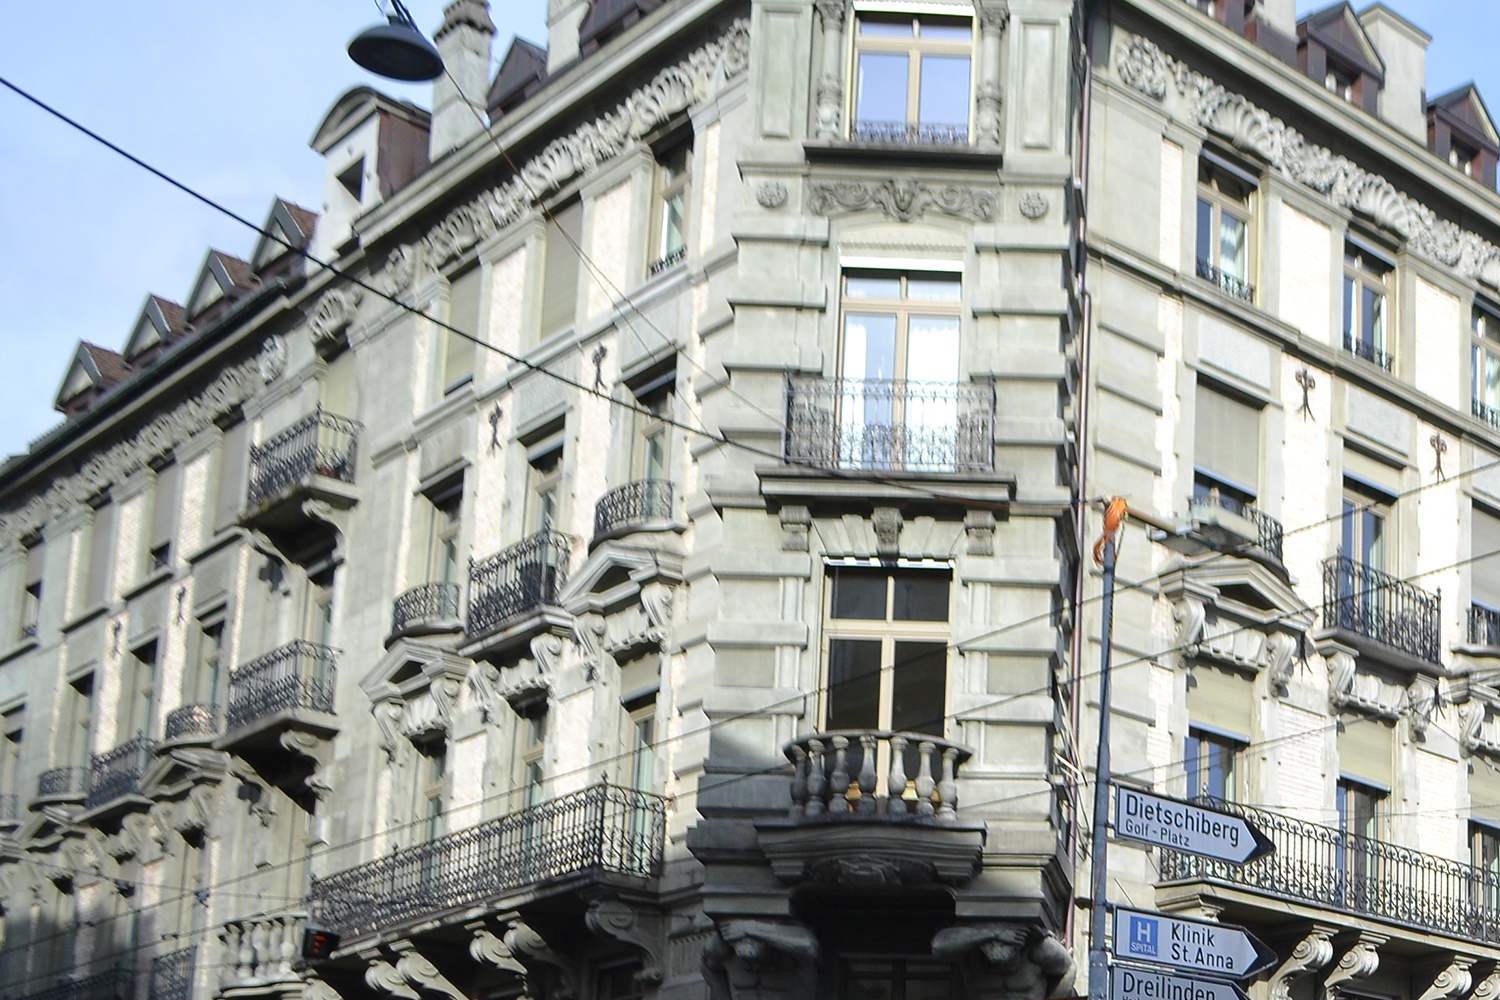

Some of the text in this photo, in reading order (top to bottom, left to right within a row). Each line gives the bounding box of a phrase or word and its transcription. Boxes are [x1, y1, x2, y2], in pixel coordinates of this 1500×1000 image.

[1125, 818, 1149, 838] Golf
[1160, 826, 1191, 848] Platz
[1126, 793, 1239, 848] Dietschiberg
[1171, 921, 1215, 948] Klinik
[1130, 942, 1158, 956] SPITAL
[1195, 947, 1234, 970] Anna
